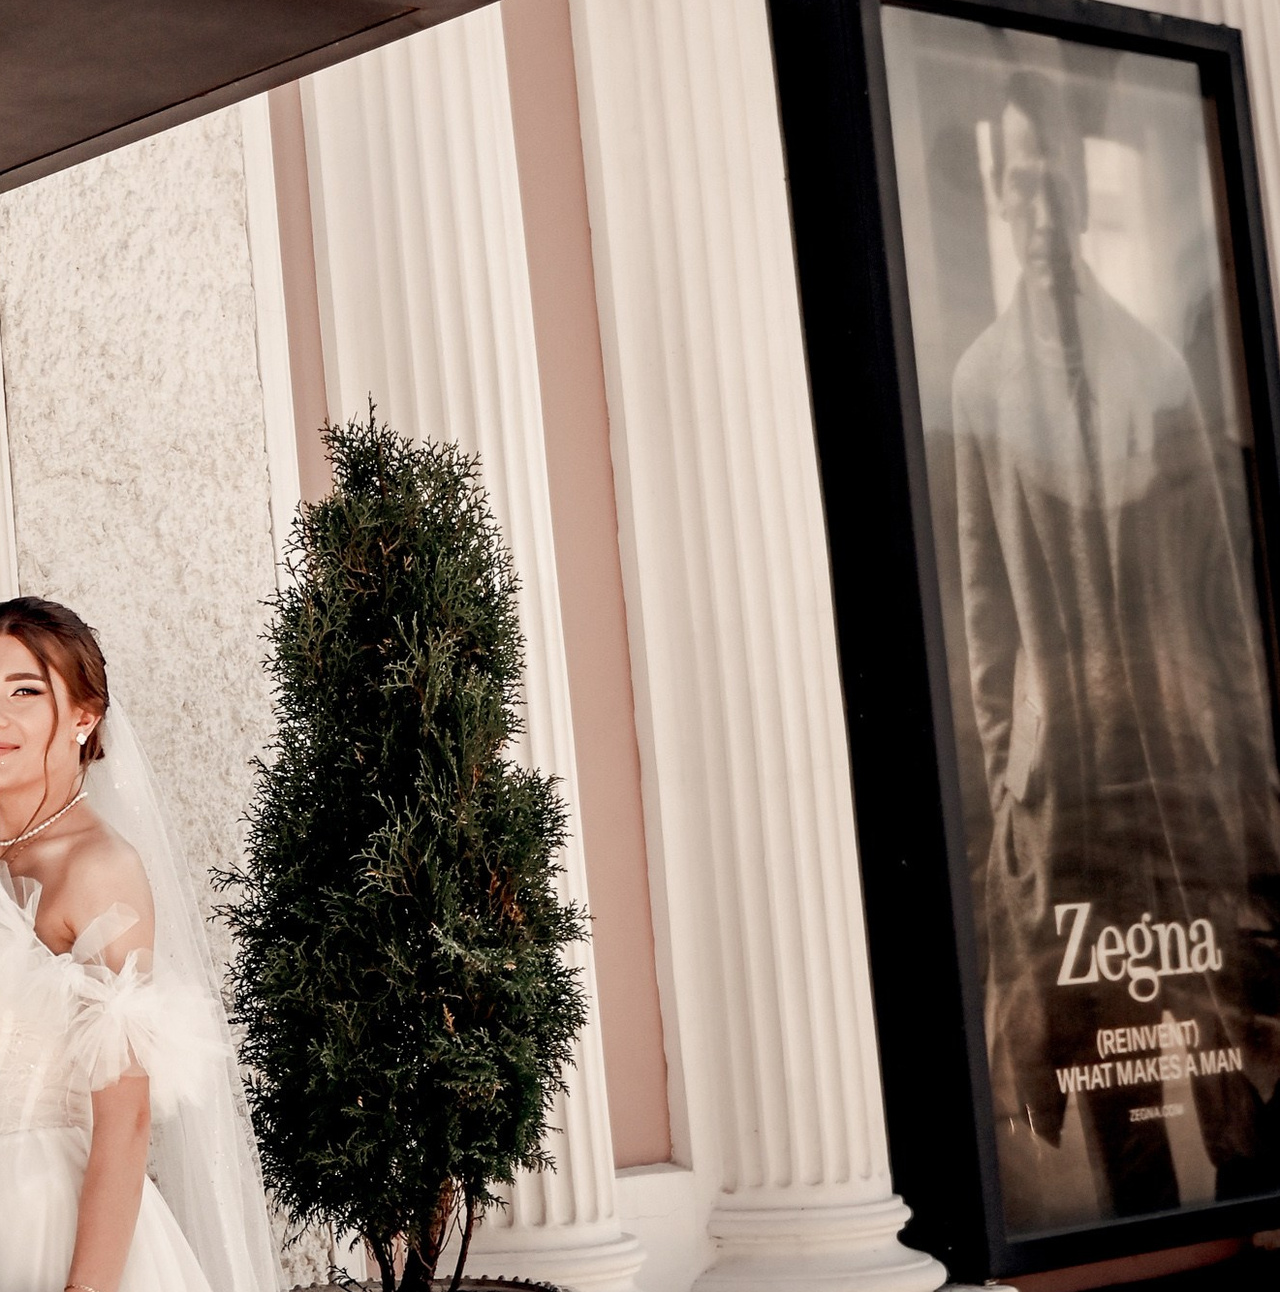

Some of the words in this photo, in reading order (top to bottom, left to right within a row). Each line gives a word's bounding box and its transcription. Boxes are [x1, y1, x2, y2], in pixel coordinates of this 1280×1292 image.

[1054, 902, 1222, 1002] Zegna
[1096, 1019, 1200, 1059] (REINVENT)
[1056, 1062, 1114, 1094] WHAT
[1116, 1055, 1183, 1087] MAKES
[1184, 1052, 1199, 1077] A
[1200, 1047, 1244, 1076] MAN
